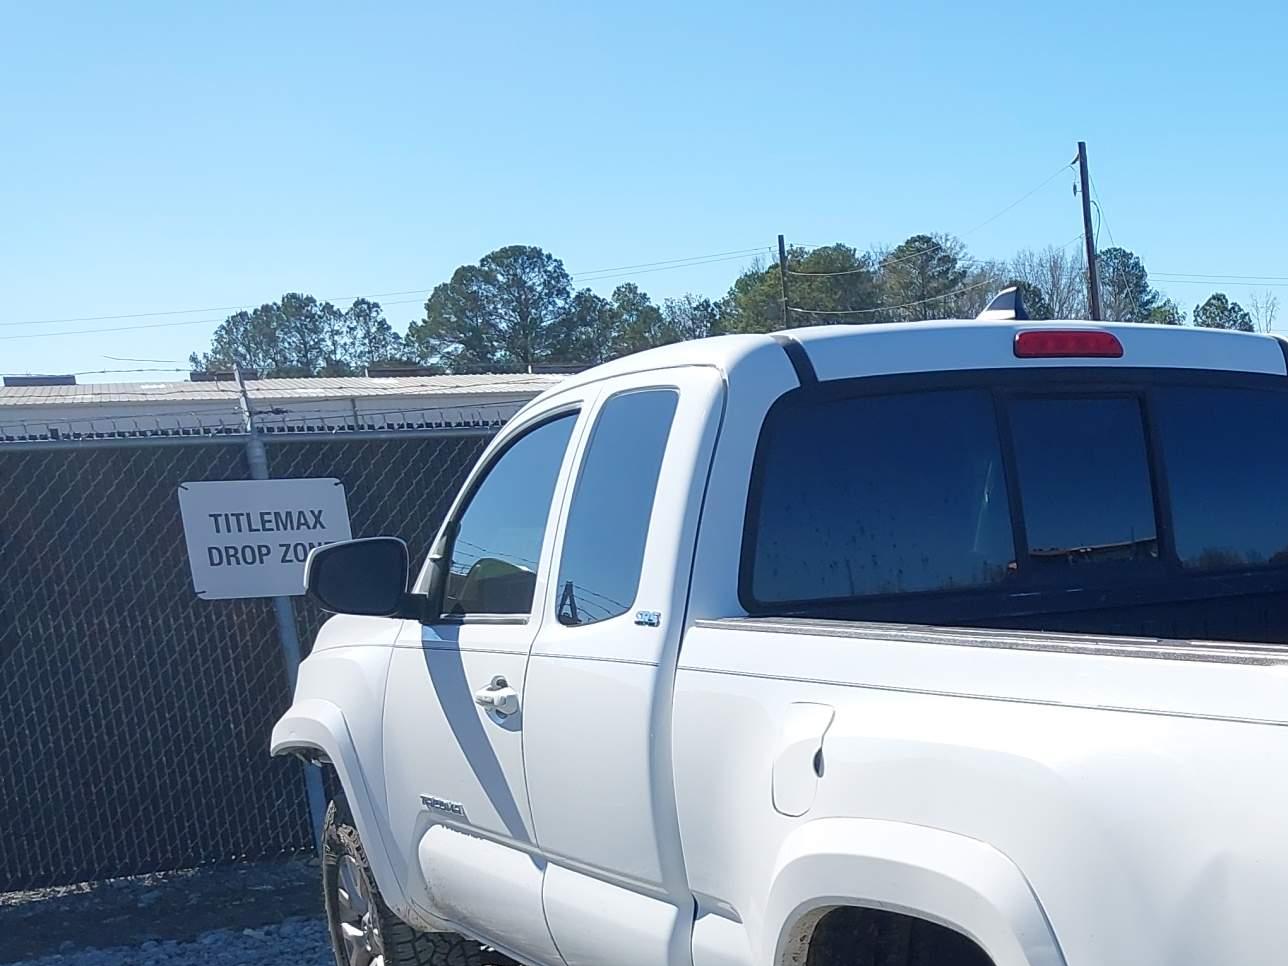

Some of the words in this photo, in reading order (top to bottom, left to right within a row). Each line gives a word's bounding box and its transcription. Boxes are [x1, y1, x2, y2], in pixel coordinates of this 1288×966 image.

[208, 509, 326, 534] TITLEMAX
[207, 544, 272, 567] DROP
[278, 541, 335, 564] ZO
